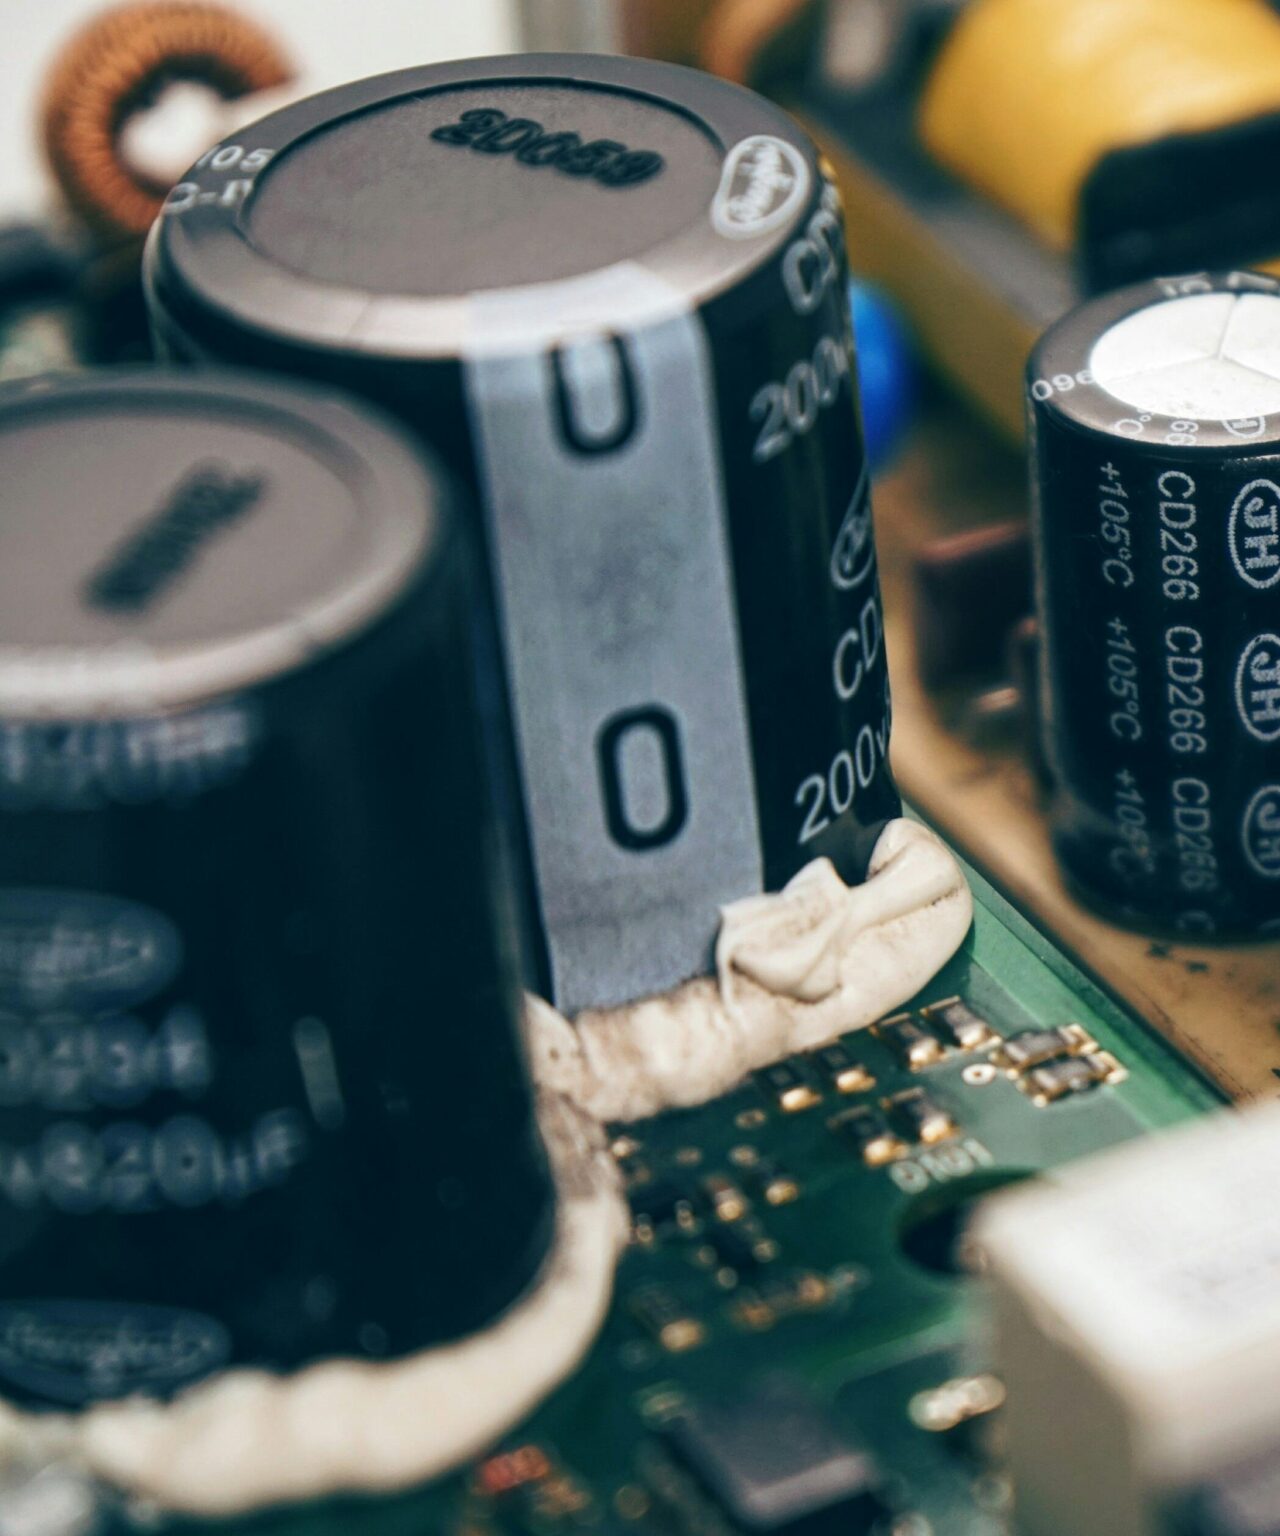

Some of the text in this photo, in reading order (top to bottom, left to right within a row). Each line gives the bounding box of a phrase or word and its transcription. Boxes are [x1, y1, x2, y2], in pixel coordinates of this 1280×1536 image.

[1100, 462, 1135, 588] +105°C
[1157, 470, 1201, 600] CD266
[1107, 616, 1142, 741] +105°C
[1164, 626, 1207, 754] CD266
[1172, 777, 1217, 892] CD266
